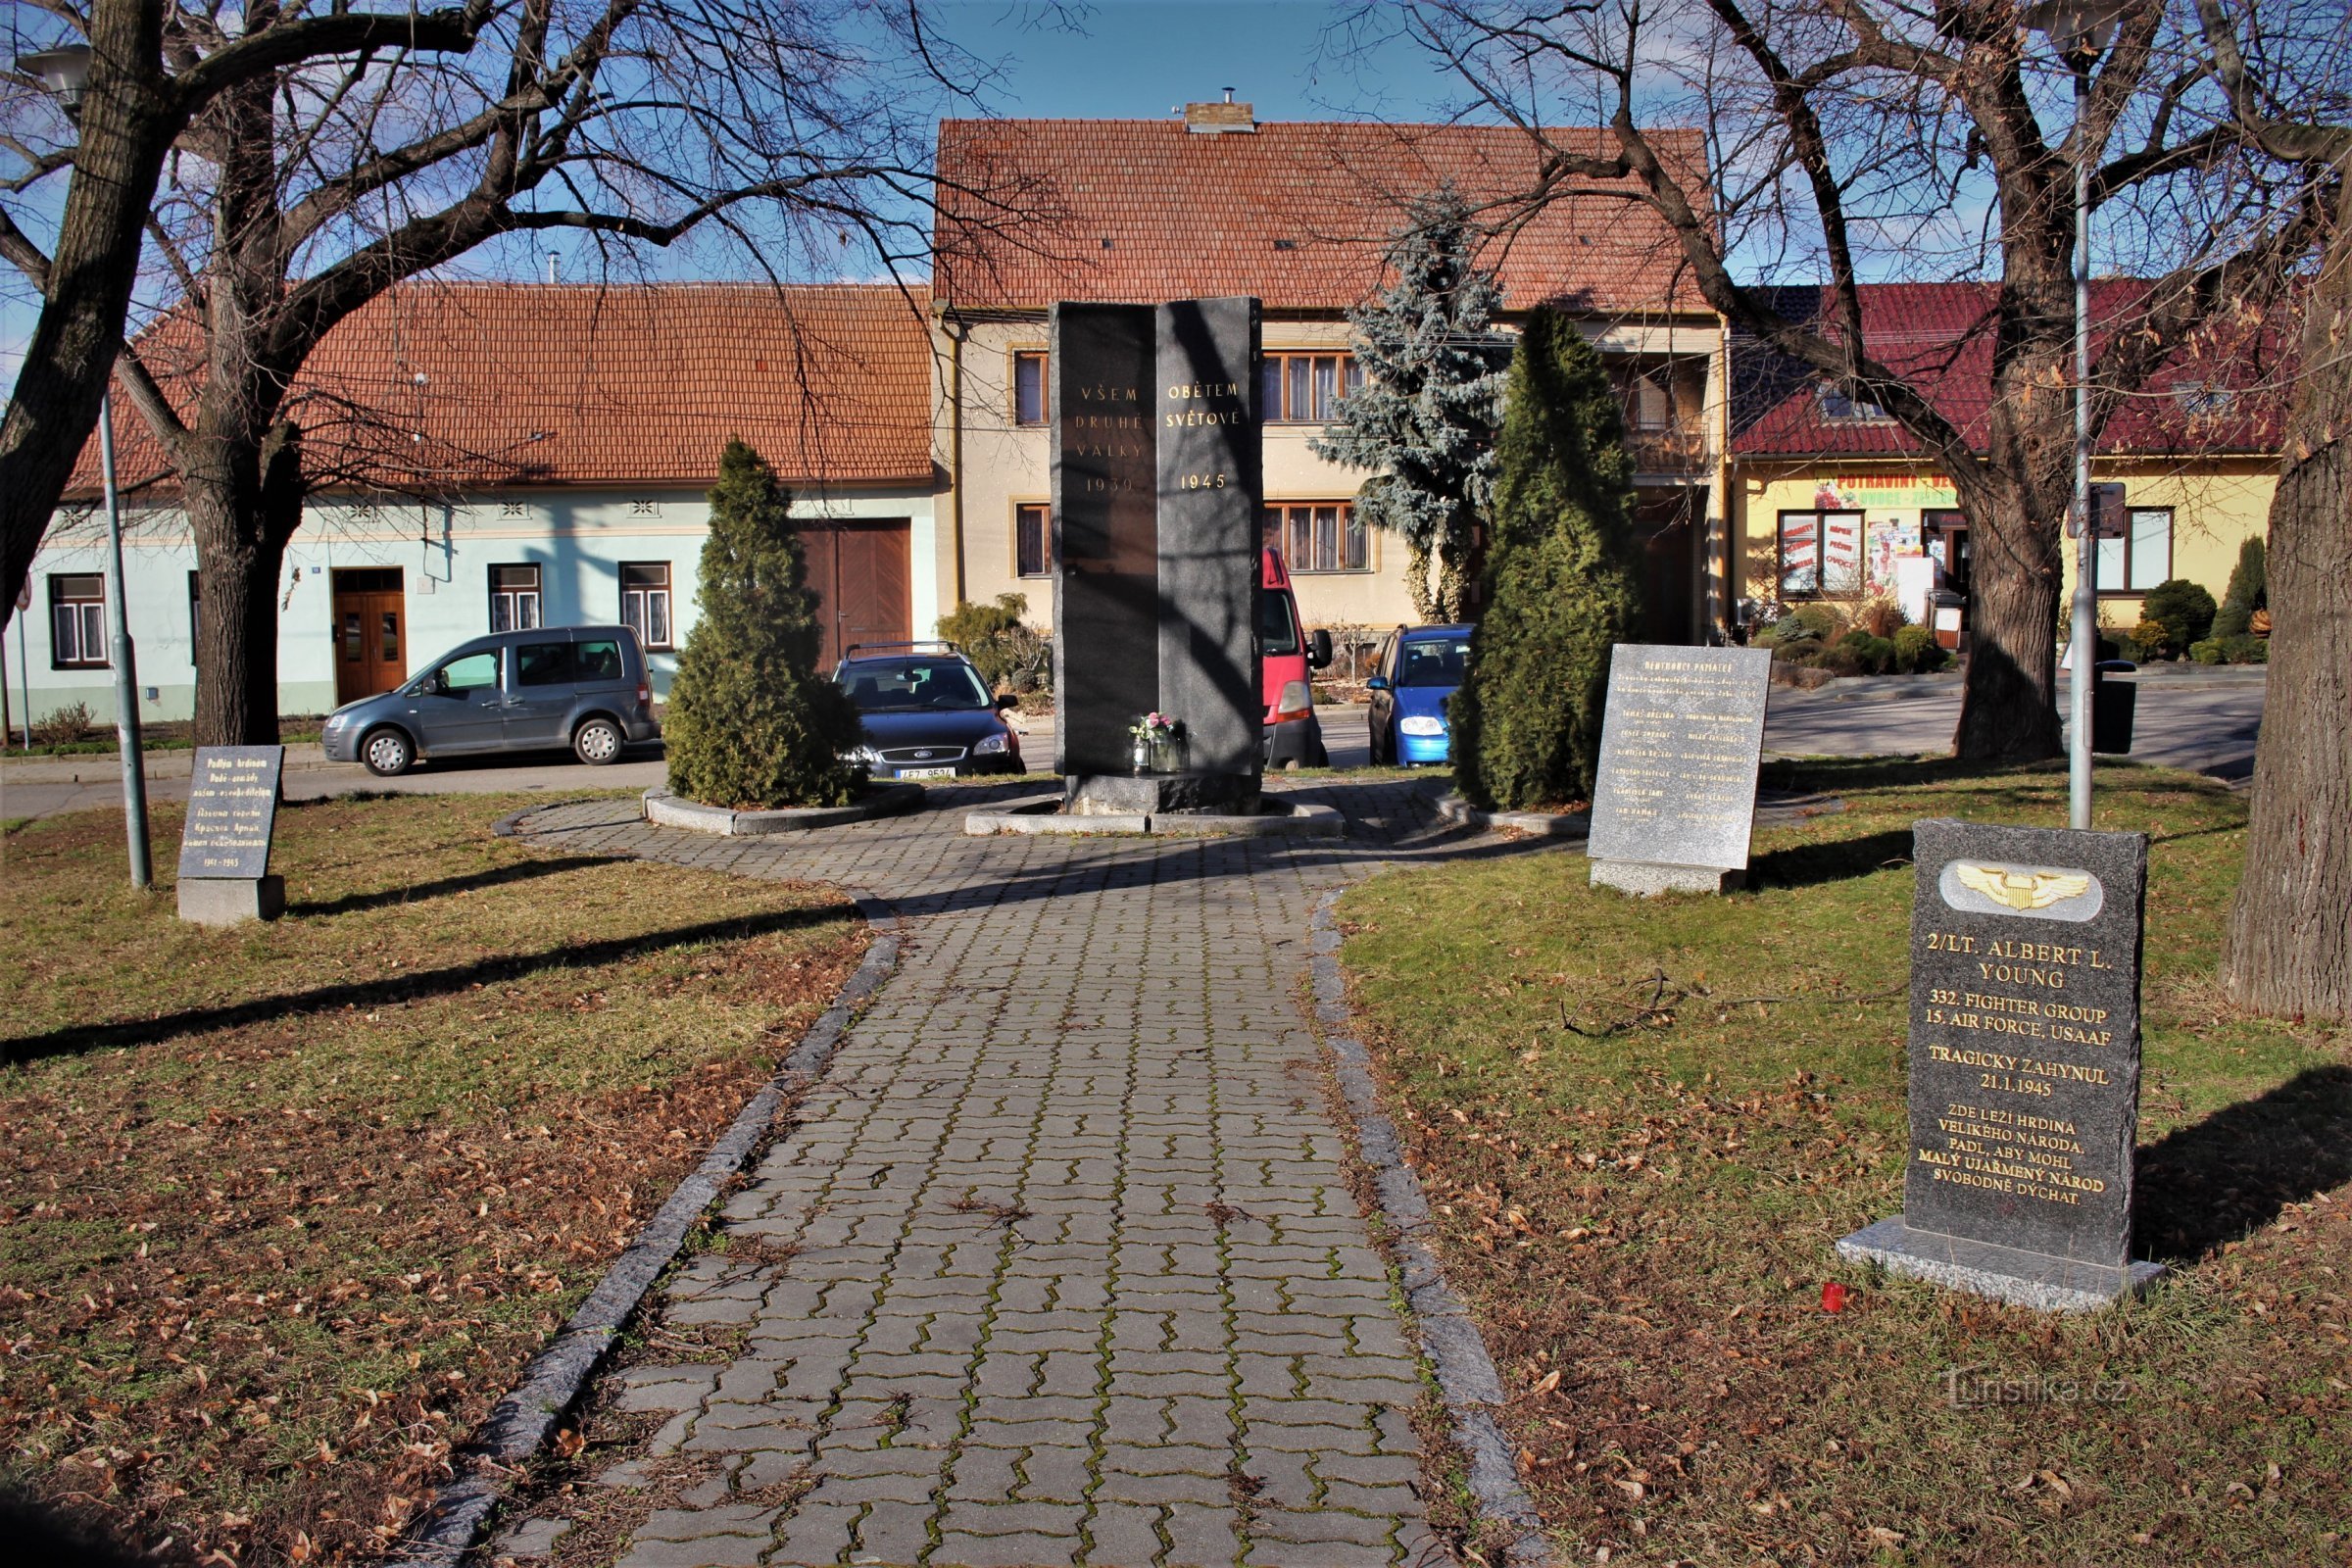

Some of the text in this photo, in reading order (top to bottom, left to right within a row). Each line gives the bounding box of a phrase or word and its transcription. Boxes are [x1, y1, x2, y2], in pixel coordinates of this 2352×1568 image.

[1081, 380, 1238, 401] VŠEM OBĚTEM
[1075, 408, 1240, 429] DRUHÉ SVĚTOVÉ
[1087, 473, 1225, 492] 1939 1945
[1838, 473, 1918, 489] POTRAVINY
[1859, 492, 1901, 505] OVOCE
[1826, 555, 1856, 569] OVOCE
[1927, 933, 2112, 969] 2/LT. ALBERT L.
[1979, 962, 2065, 989] YOUNG
[1930, 989, 2107, 1024] 332. FIGHTER GROUP
[1926, 1008, 2112, 1047] 15. AIR FORCE, USAAF
[1929, 1045, 2110, 1085] TRAGICKY ZAHYNUL
[1980, 1074, 2052, 1097] 21.1.1945
[1938, 1118, 2085, 1154] VELIKÉHO NÁRODA.
[1948, 1103, 2077, 1136] ZDE LEŽÍ HRDINA
[1948, 1137, 2073, 1170] PADL, ABY MOHL
[1918, 1149, 2105, 1193] MALÝ UJAŘMENÝ NÁROD
[1934, 1167, 2082, 1205] SVOBODNĚ DÝCHAT.
